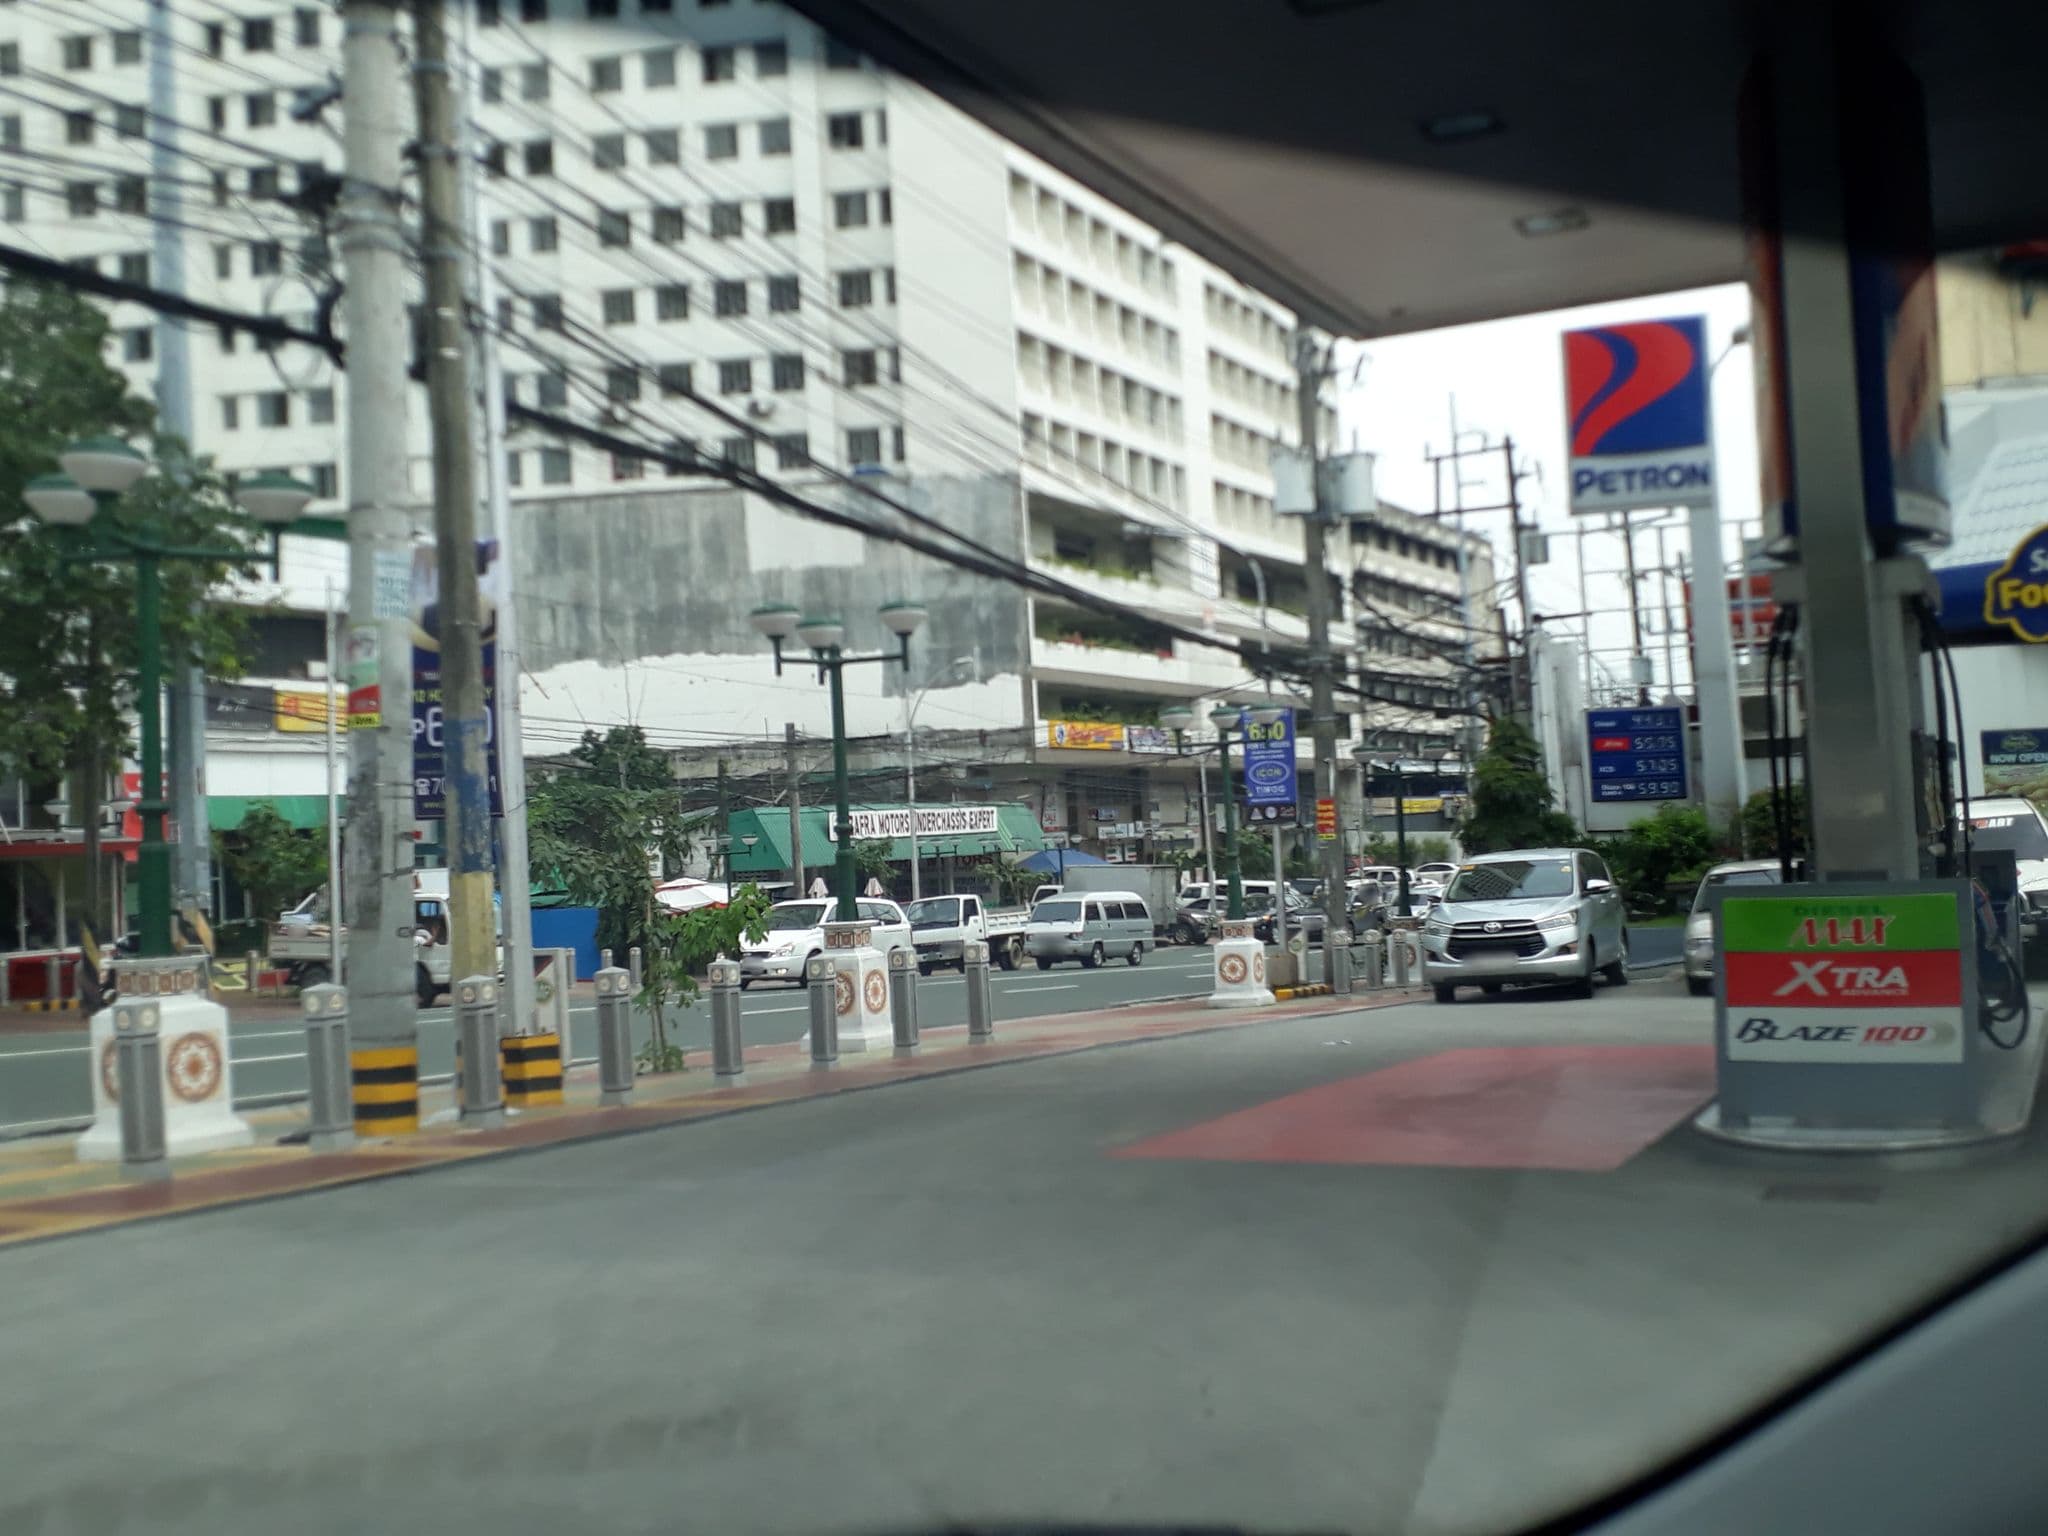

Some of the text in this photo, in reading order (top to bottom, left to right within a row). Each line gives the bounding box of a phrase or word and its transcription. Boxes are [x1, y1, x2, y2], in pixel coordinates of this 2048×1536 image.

[1574, 462, 1710, 496] PETRON
[878, 813, 910, 835] MOTORS
[969, 809, 995, 829] EXPERT
[1772, 960, 1909, 996] XTRA
[1736, 1018, 1927, 1043] BLAZE 100
